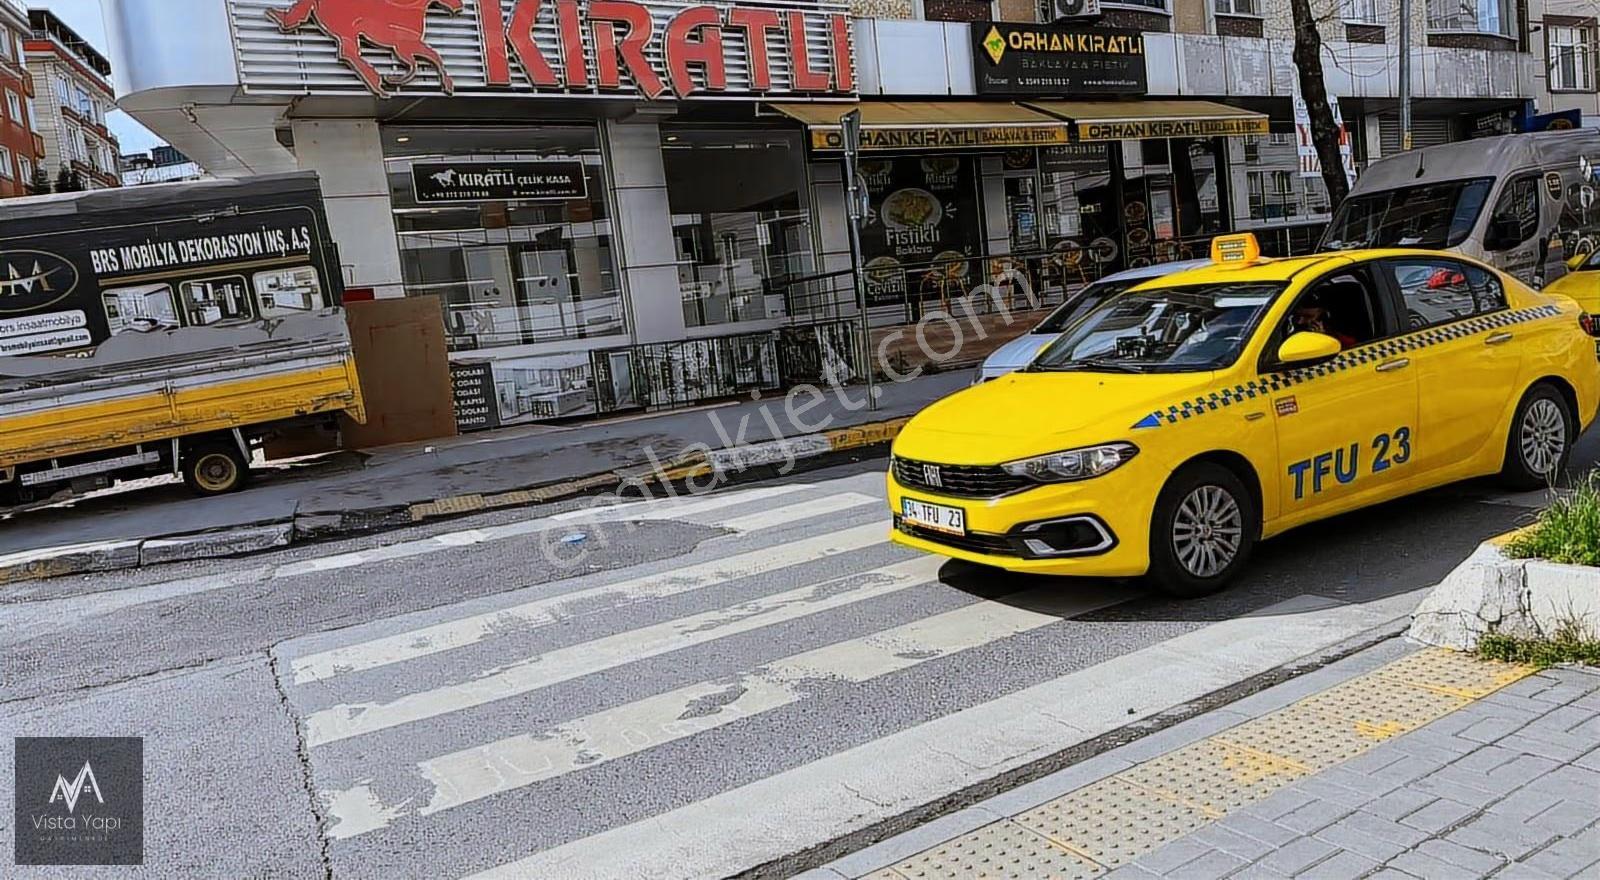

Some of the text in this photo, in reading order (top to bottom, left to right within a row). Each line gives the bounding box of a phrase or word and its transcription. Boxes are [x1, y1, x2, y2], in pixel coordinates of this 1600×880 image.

[470, 0, 853, 99] KIRATLI
[1008, 31, 1143, 54] ORHAN KIRATLI
[826, 129, 904, 147] OHAN
[906, 128, 979, 146] KIRATLI
[1089, 123, 1145, 139] ORHAN
[1149, 121, 1202, 137] KIRATLI
[459, 172, 571, 187] KIRATLI ÇELİK KASA
[90, 248, 119, 273] BRS
[120, 239, 178, 271] MOBİLYA
[178, 232, 263, 263] DEKORASYON
[262, 226, 290, 257] İNŞ.
[1288, 426, 1411, 500] TFU 23
[906, 501, 961, 527] 34 TFU 23
